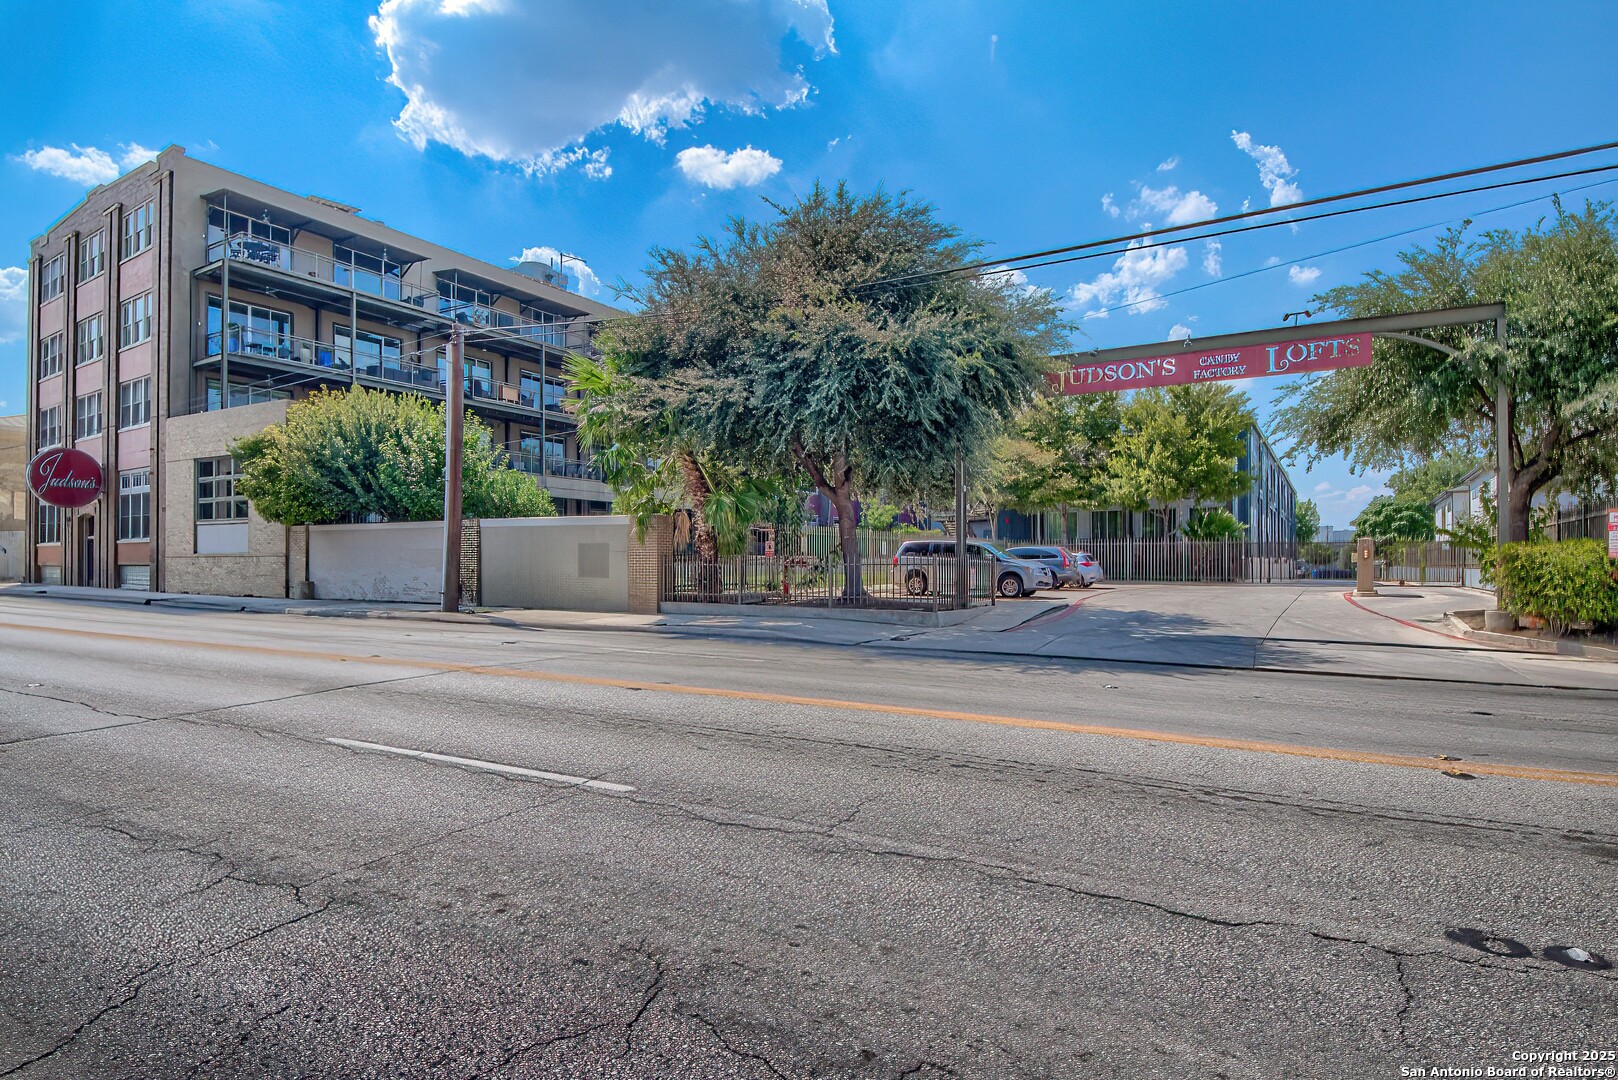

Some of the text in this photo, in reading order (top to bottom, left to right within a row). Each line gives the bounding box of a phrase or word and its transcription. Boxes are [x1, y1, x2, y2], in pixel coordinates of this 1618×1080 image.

[1193, 365, 1247, 380] FACTORY
[1199, 352, 1241, 366] CANDY
[1266, 337, 1360, 373] LOFTS
[1051, 358, 1176, 394] JUDSON'S
[38, 452, 98, 495] Judson's
